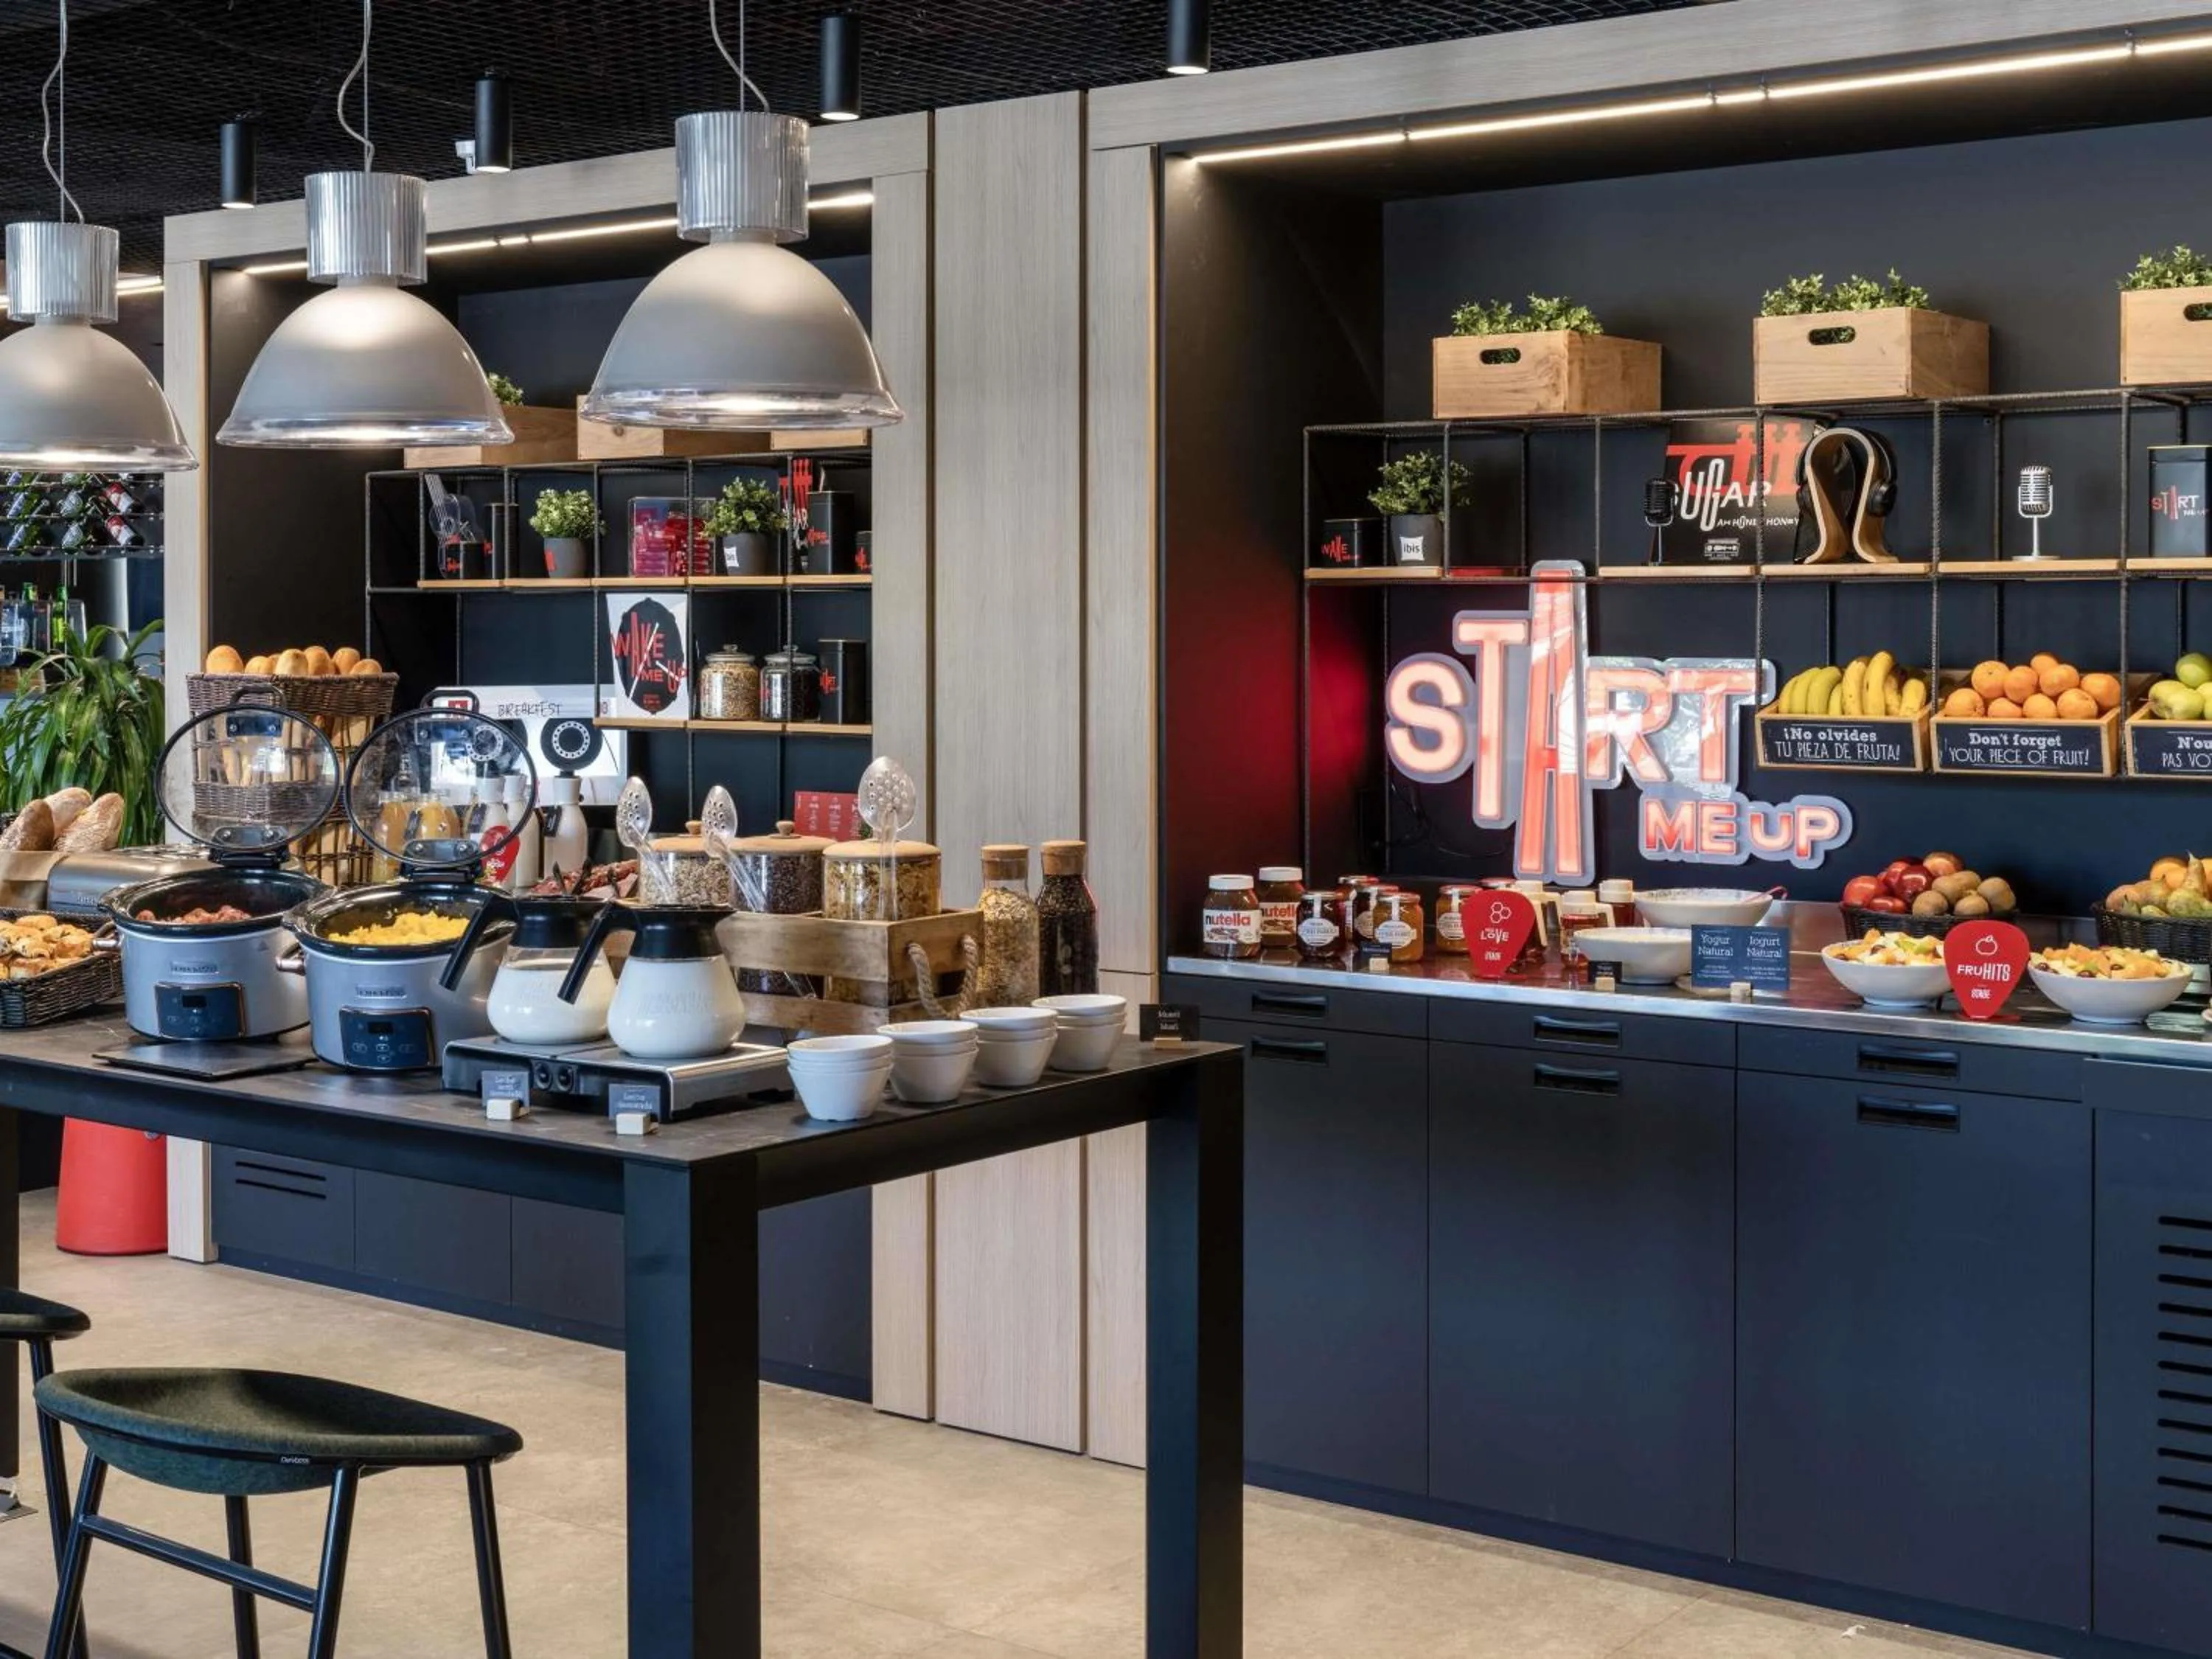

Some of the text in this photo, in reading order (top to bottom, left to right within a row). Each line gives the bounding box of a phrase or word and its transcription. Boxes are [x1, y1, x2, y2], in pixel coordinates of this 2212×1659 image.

[1403, 542, 1420, 554] ibis
[611, 611, 666, 678] WAKE
[641, 669, 664, 682] ME
[1389, 569, 1757, 877] START
[1818, 728, 1877, 742] olvides
[1968, 732, 2062, 750] Don't forget
[1775, 740, 1900, 762] TU PIEZA DE FRUTA!
[1948, 746, 2089, 766] YOUR PIECE OF FRUIT!
[2162, 752, 2183, 768] PAS
[1644, 798, 1840, 859] ME UP
[1206, 912, 1251, 927] nutella
[1481, 928, 1509, 944] LOVE
[1701, 933, 1731, 946] Yogur
[1750, 935, 1781, 947] Iogurt
[1698, 946, 1733, 956] Natural
[1746, 947, 1782, 958] Natural
